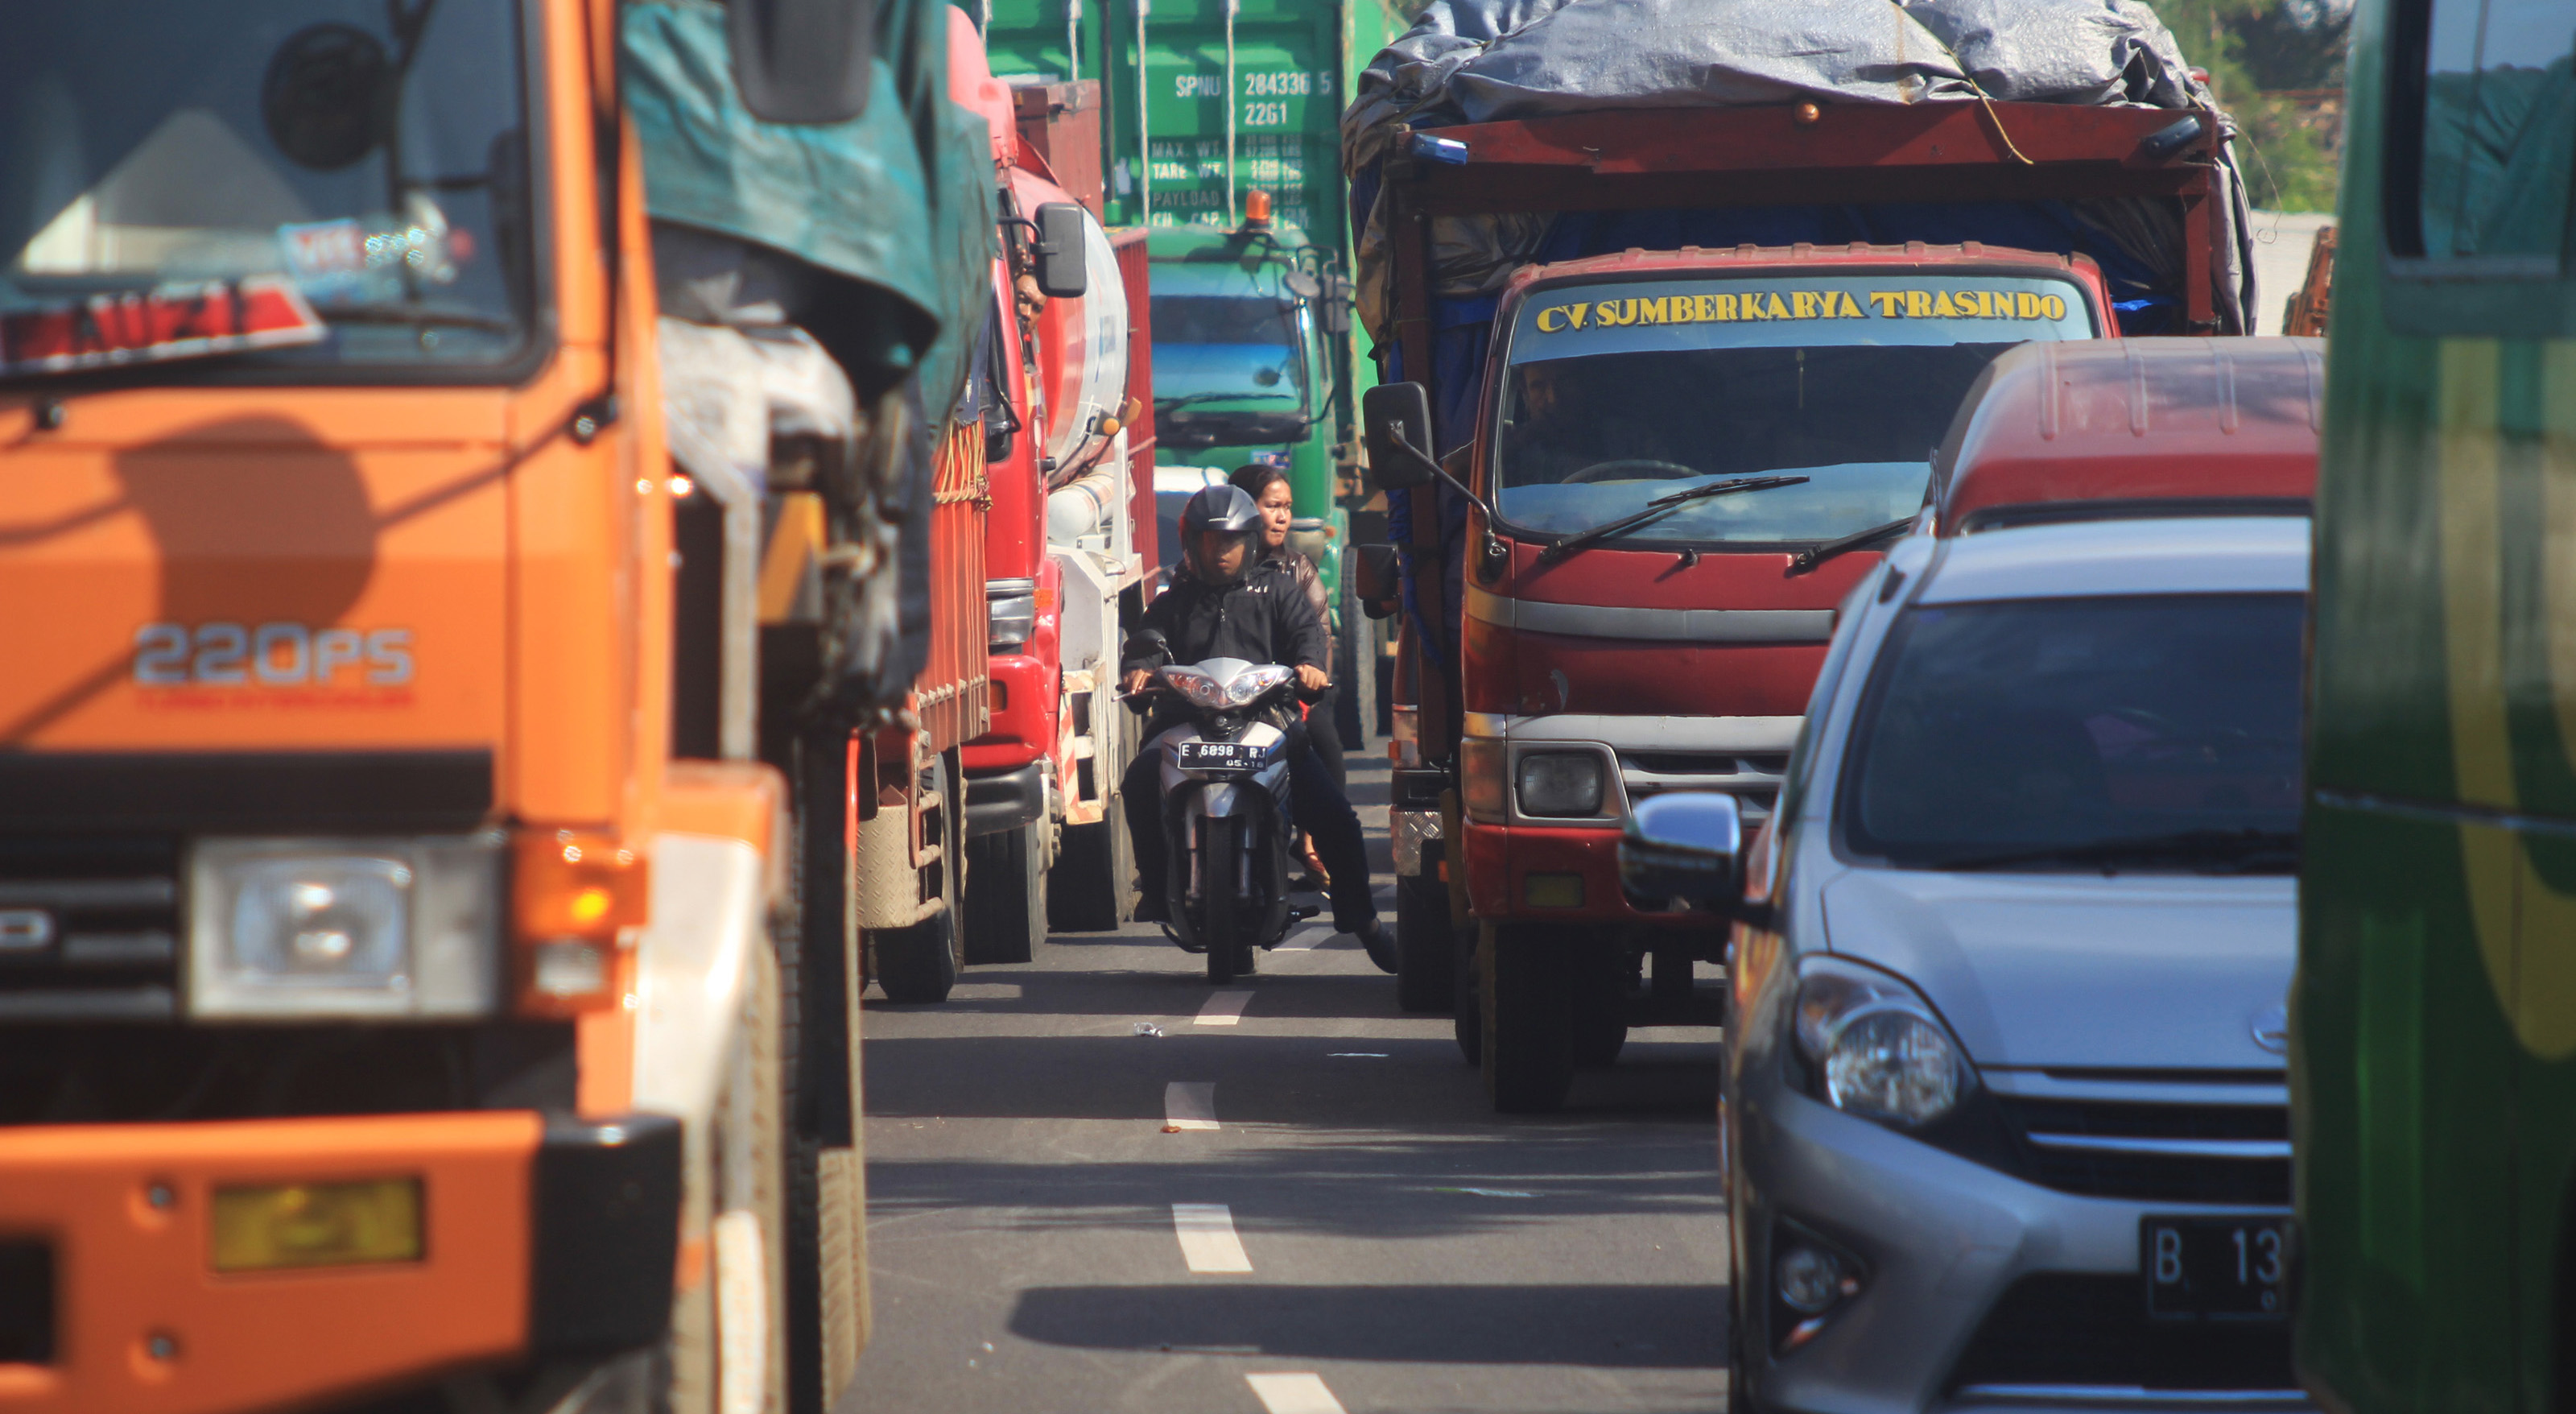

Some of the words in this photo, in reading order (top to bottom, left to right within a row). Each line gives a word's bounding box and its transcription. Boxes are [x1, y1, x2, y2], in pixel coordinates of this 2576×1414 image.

[1175, 76, 1221, 97] SPNU
[1245, 72, 1310, 96] 284336
[1320, 71, 1332, 95] 5
[1152, 143, 1191, 158] MAX.
[1153, 163, 1187, 180] TARE
[1154, 191, 1220, 206] PAYLOAD
[1537, 303, 1592, 333] CV.
[1596, 291, 1866, 327] SUMBERKARYA
[1870, 290, 2066, 320] TRASINDO
[134, 622, 412, 684] 220PS
[1182, 745, 1190, 756] E
[2156, 1228, 2182, 1284] B
